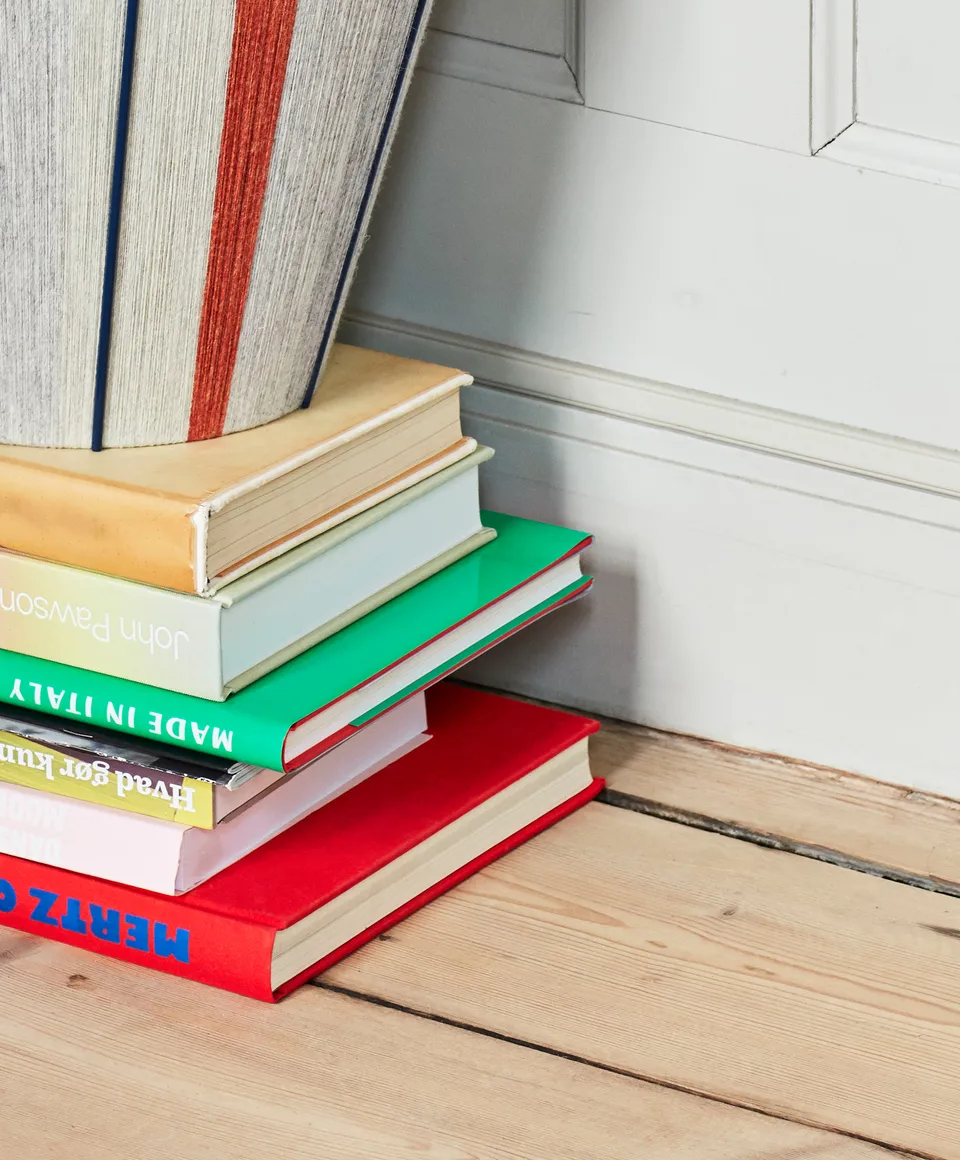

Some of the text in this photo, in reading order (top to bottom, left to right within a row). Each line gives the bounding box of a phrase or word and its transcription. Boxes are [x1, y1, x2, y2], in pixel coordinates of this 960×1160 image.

[120, 616, 189, 660] John
[9, 678, 234, 753] MADE IN ITALY
[59, 757, 112, 787] gør
[115, 770, 196, 813] Hvad
[29, 887, 190, 964] MERTZ
